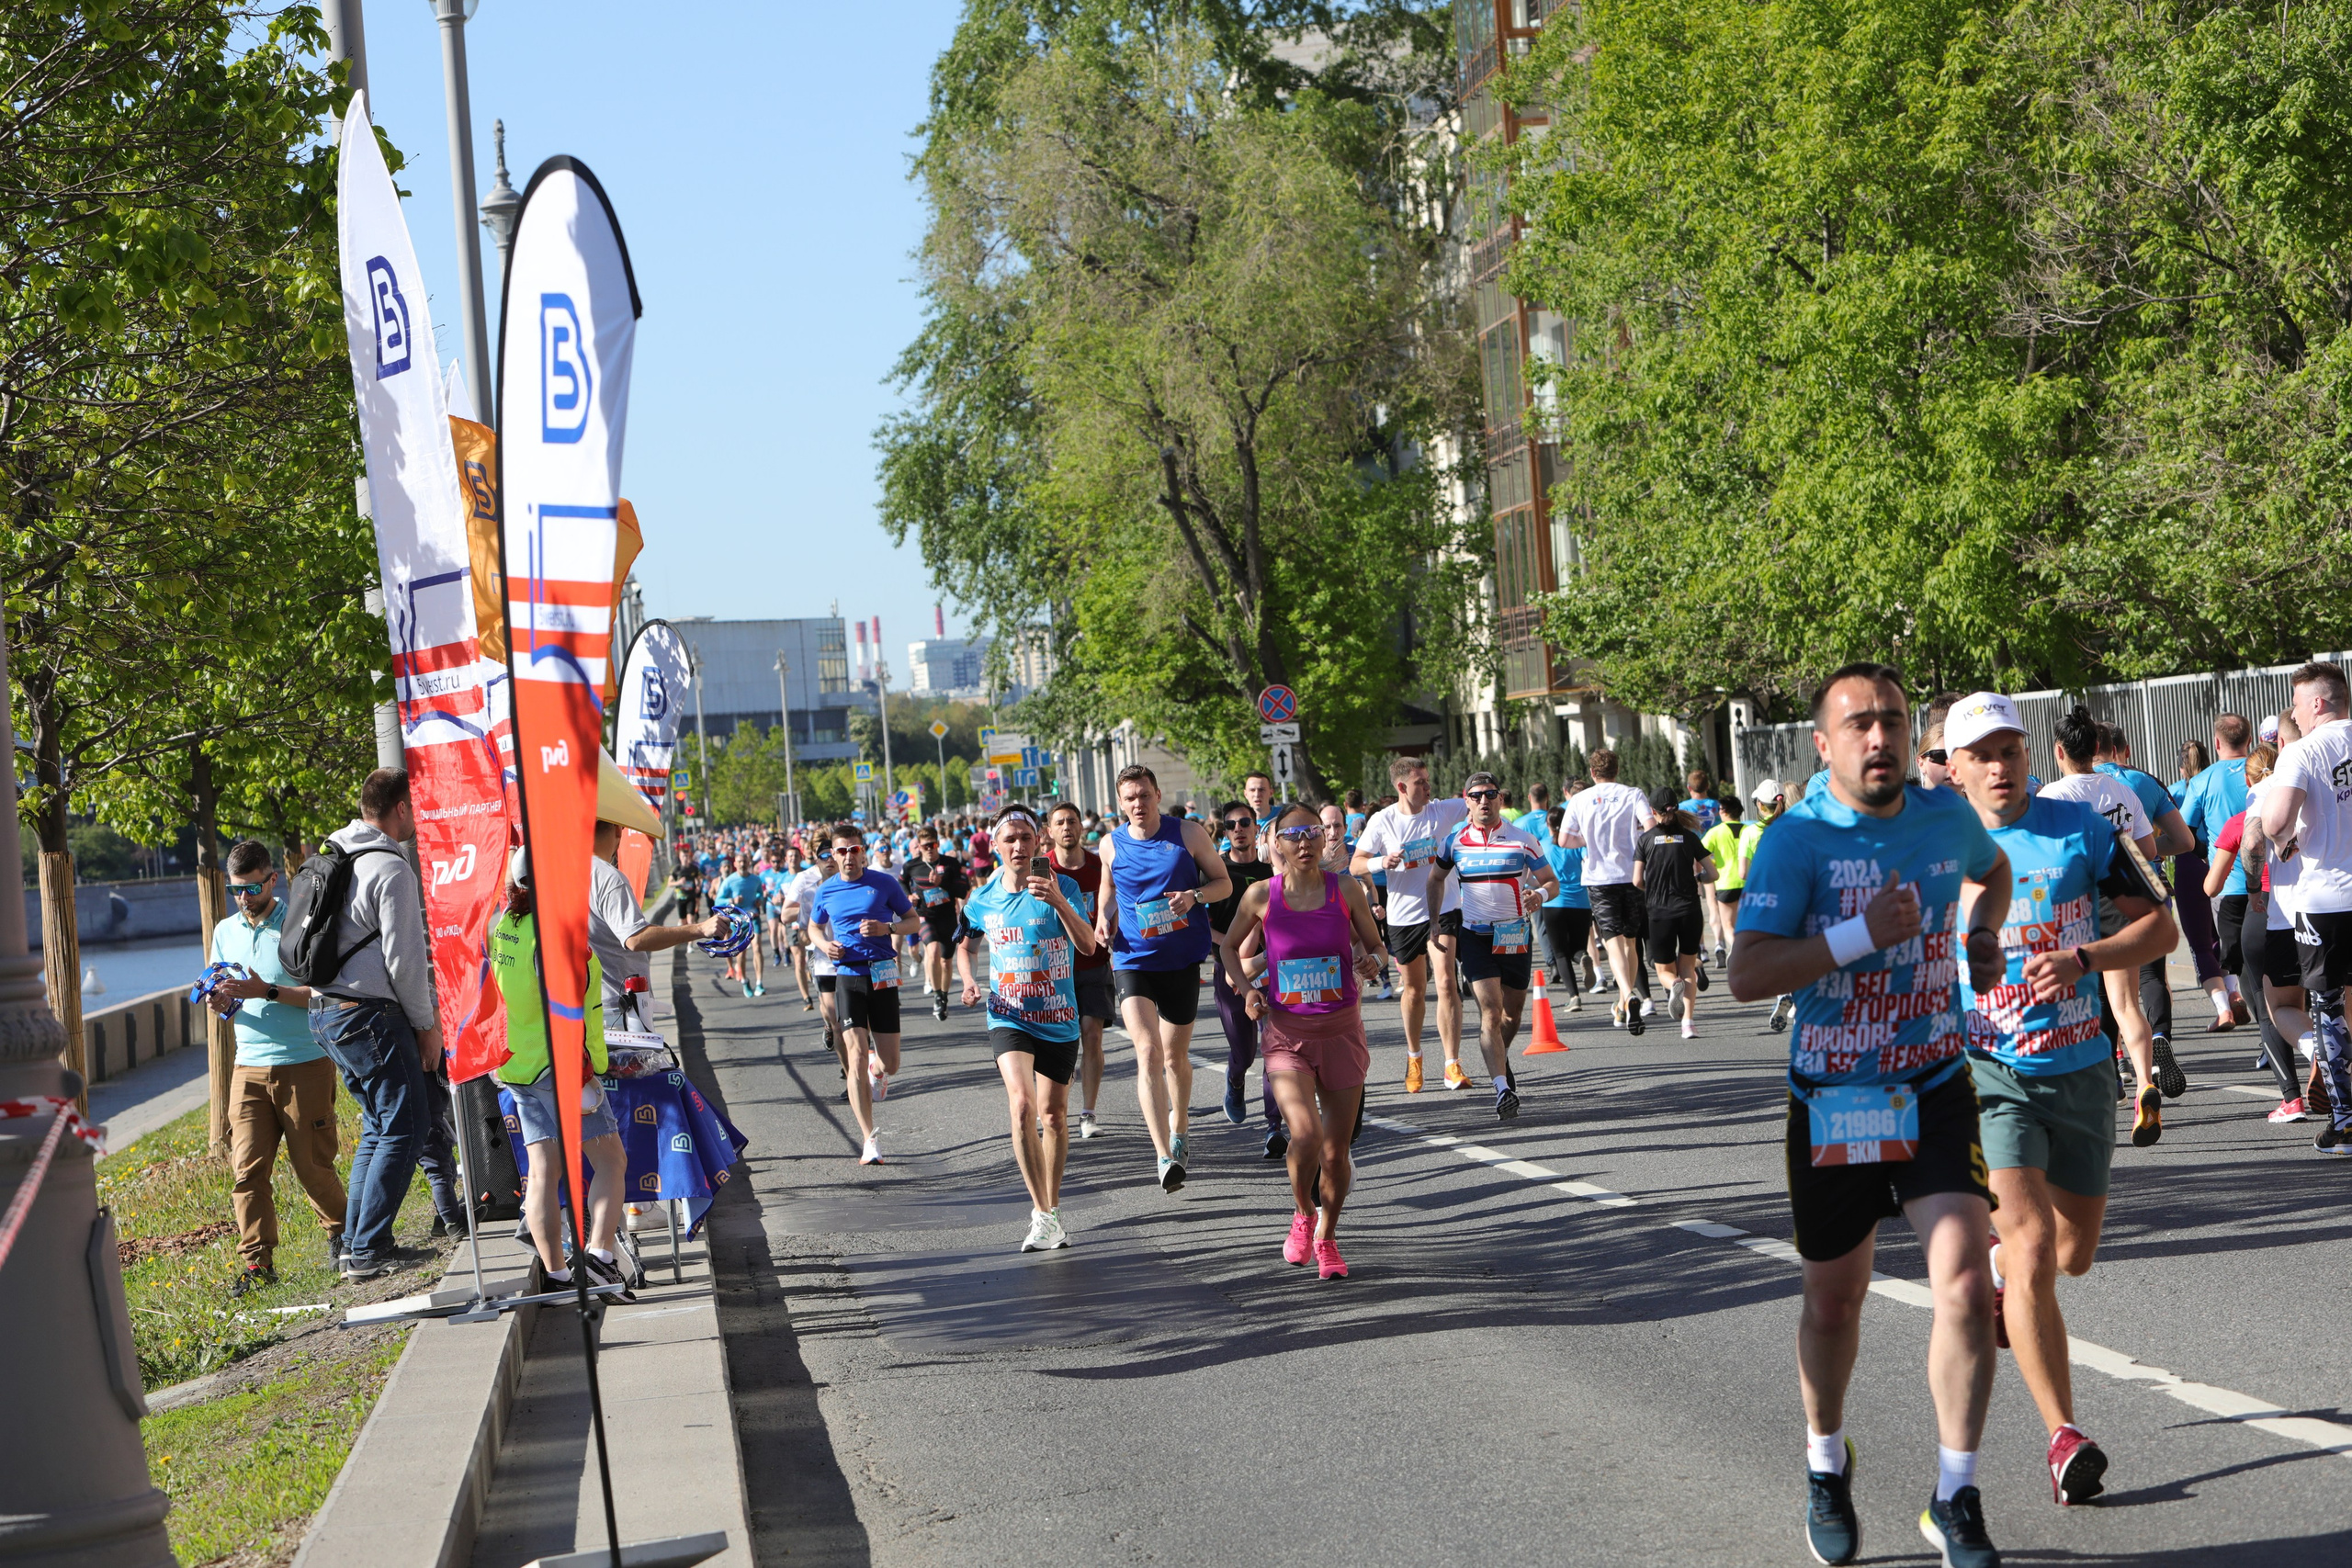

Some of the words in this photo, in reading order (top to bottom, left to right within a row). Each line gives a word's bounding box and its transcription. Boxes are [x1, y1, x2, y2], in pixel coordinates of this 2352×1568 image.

[469, 799, 503, 815] ПАРТНЕР
[1467, 858, 1518, 867] CUBE
[1828, 859, 1883, 888] 2024
[1004, 955, 1040, 971] 26400
[1047, 950, 1069, 968] 2024
[1292, 971, 1328, 990] 24141
[1816, 968, 1892, 999] #ЗАБЕГ
[998, 982, 1056, 998] #ГОРДОСТЬ
[1043, 994, 1068, 1010] 2024
[2057, 994, 2093, 1026] 2024
[1829, 1109, 1897, 1140] 21986
